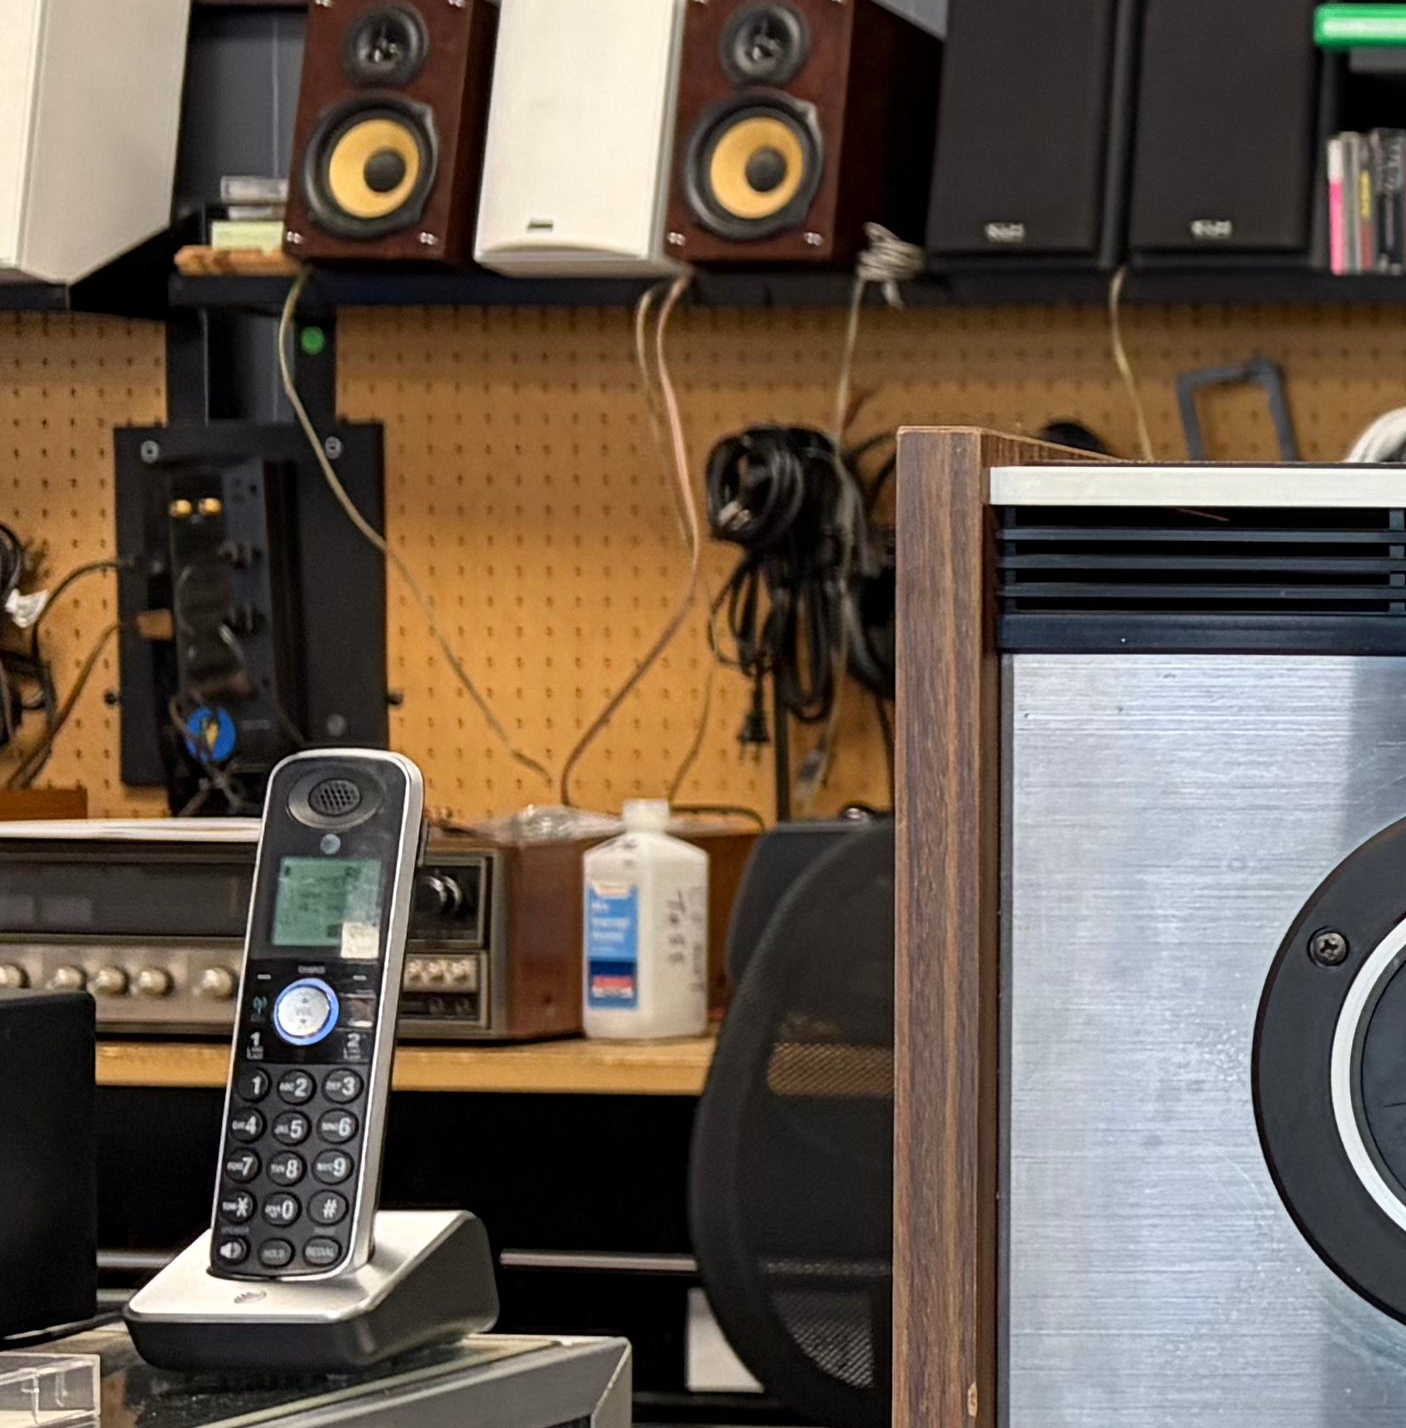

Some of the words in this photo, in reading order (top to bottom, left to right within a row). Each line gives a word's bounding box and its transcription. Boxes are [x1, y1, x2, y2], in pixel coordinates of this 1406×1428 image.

[252, 1076, 261, 1095] 1
[294, 1077, 308, 1097] 2
[342, 1076, 356, 1096] 3
[245, 1115, 257, 1135] 4
[290, 1119, 303, 1139] 5
[338, 1117, 352, 1137] 6
[241, 1156, 254, 1176] 7
[285, 1158, 298, 1179] 8
[332, 1157, 346, 1177] 9
